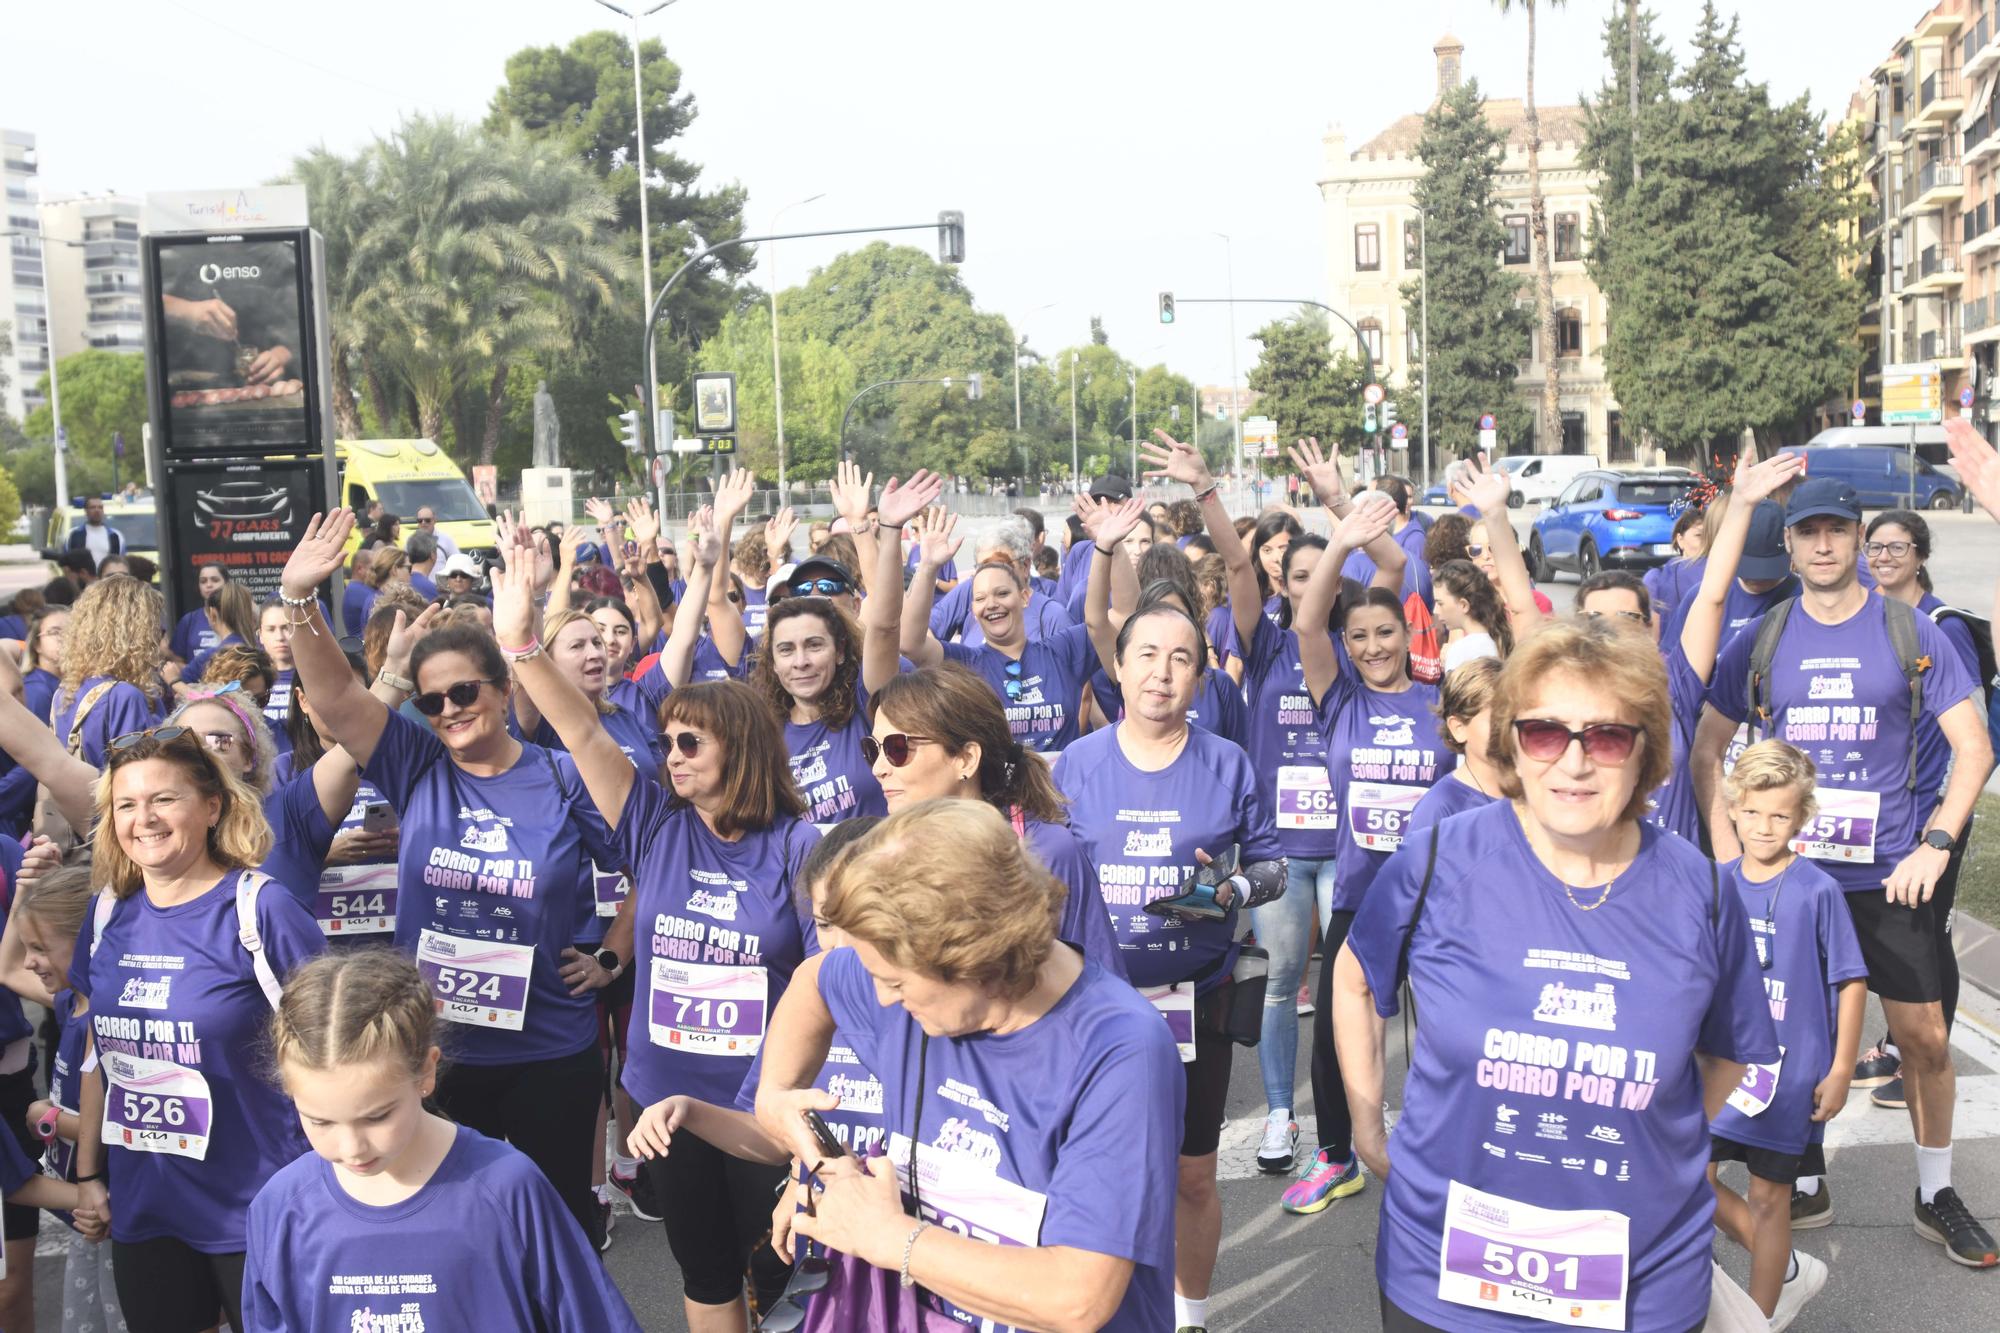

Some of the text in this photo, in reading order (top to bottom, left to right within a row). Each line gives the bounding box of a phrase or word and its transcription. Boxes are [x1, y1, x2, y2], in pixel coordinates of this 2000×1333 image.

[222, 265, 260, 279] enso
[236, 519, 280, 531] CARS
[232, 531, 290, 541] COMPRAVENTA
[255, 552, 268, 564] TU
[1034, 704, 1052, 719] POR
[1053, 704, 1063, 717] TI
[1280, 695, 1312, 710] CORR
[1278, 710, 1313, 725] CORRO
[1787, 706, 1876, 725] CORRO POR TI
[1032, 718, 1051, 733] POR
[1785, 724, 1827, 741] CORRO
[1829, 724, 1857, 741] POR
[1351, 748, 1435, 767] CORRO POR TI
[1351, 764, 1389, 780] CORRO
[1392, 765, 1417, 781] POR
[812, 775, 849, 803] POR TI
[815, 797, 839, 821] POR
[430, 847, 533, 880] CORRO POR TI
[424, 865, 536, 899] CORRO POR MÍ
[1100, 864, 1146, 885] CORRO
[1149, 866, 1179, 886] POR
[1100, 884, 1141, 905] CORRO
[331, 893, 385, 917] 544
[655, 913, 759, 955] CORRO POR TI
[652, 934, 700, 961] CORRO
[703, 943, 735, 965] POR
[437, 967, 500, 1001] 524
[452, 1004, 478, 1013] KIA
[673, 996, 739, 1029] 710
[94, 1015, 195, 1043] CORRO POR TI
[689, 1034, 717, 1042] KIA
[142, 1042, 174, 1062] POR
[177, 1039, 201, 1065] MÍ
[1484, 1028, 1656, 1083] CORRO POR TI
[1476, 1058, 1660, 1111] CORRO POR MÍ
[124, 1091, 185, 1126] 526
[140, 1131, 168, 1140] KIA
[1482, 1241, 1579, 1291] 501
[343, 1275, 374, 1286] CARRERA
[374, 1275, 384, 1285] DE
[384, 1275, 398, 1285] LAS
[399, 1274, 432, 1285] CIUDADES
[1510, 1279, 1554, 1295] GREGORIA
[329, 1285, 354, 1295] CONTRA
[355, 1285, 363, 1295] EL
[390, 1284, 401, 1294] DE
[1512, 1289, 1552, 1305] KIA
[401, 1303, 420, 1313] 2022
[369, 1312, 422, 1326] CARRERA
